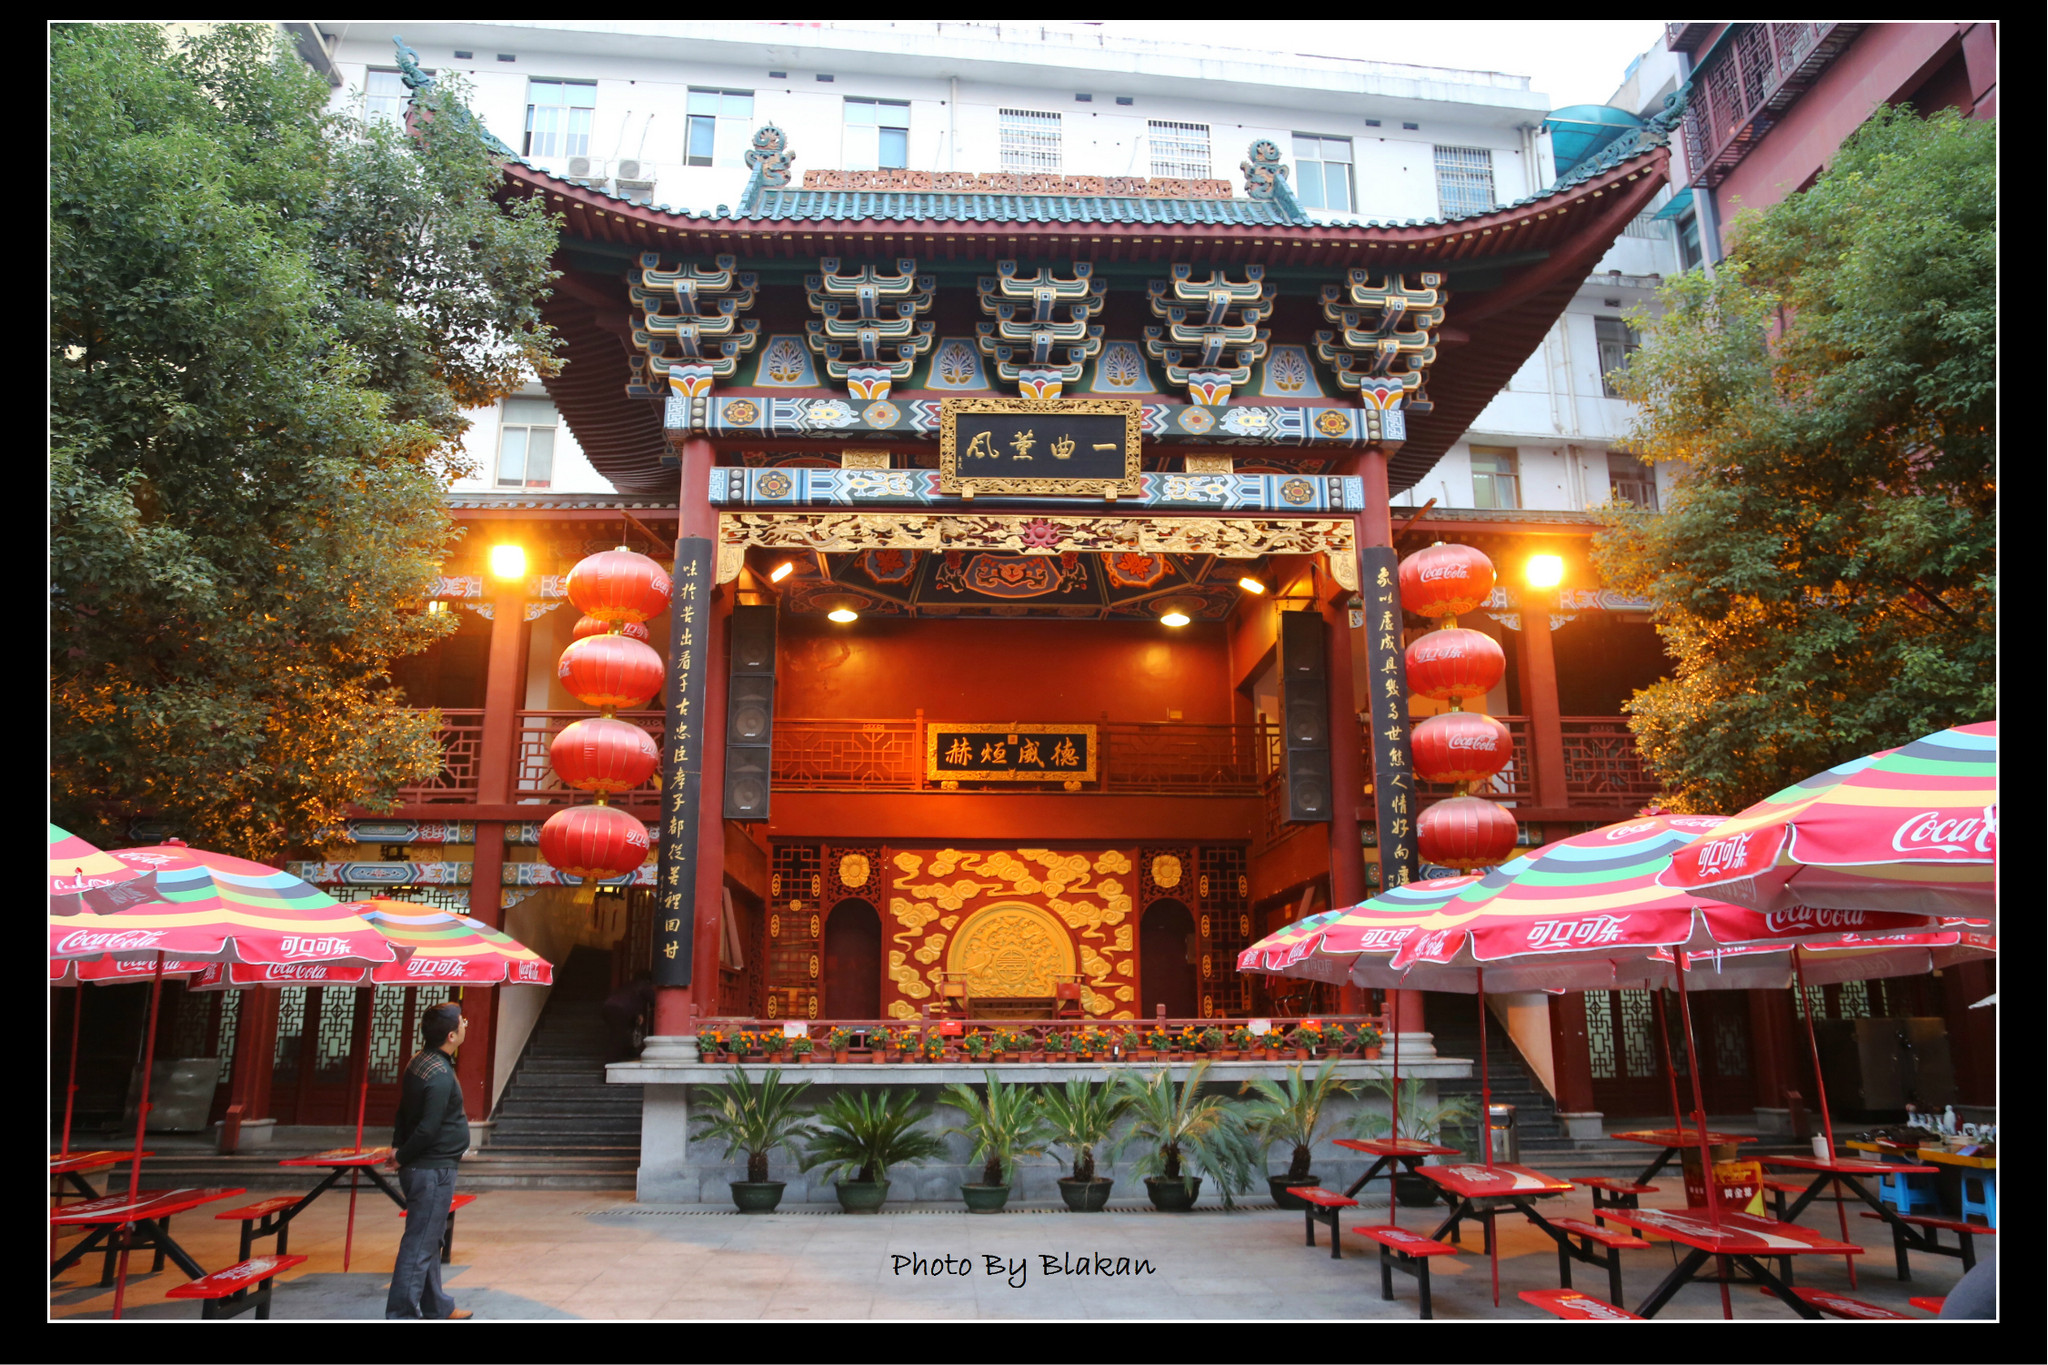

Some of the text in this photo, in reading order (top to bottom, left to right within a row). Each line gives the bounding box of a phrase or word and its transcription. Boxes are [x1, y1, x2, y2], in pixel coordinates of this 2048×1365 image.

[1697, 832, 1755, 877] 可口可乐
[56, 929, 170, 953] Coca-Cola
[1526, 914, 1632, 948] 可口可乐
[280, 935, 352, 958] 可口可乐
[265, 963, 328, 980] CocaCola
[406, 957, 470, 978] 可口可乐
